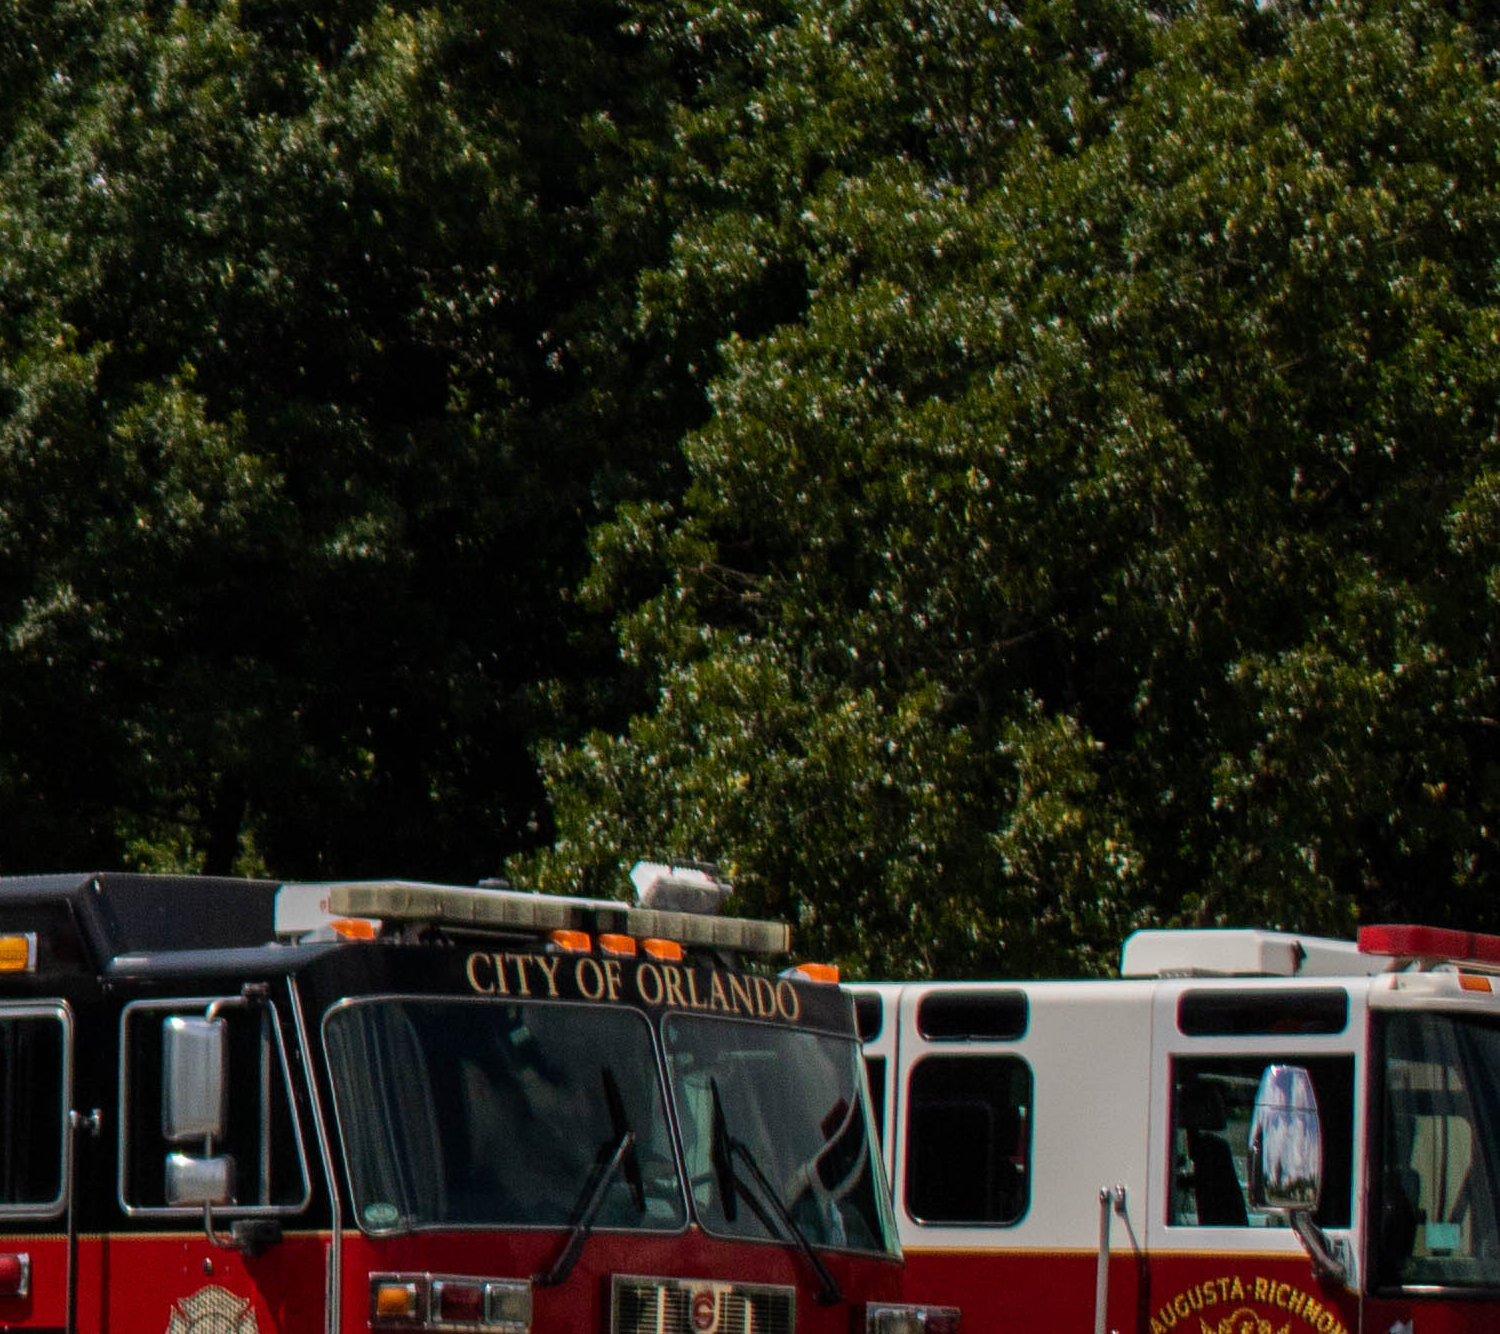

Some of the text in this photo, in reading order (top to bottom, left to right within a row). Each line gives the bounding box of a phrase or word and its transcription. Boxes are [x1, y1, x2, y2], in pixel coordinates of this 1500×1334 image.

[466, 951, 800, 1021] CITY OF ORLANDO
